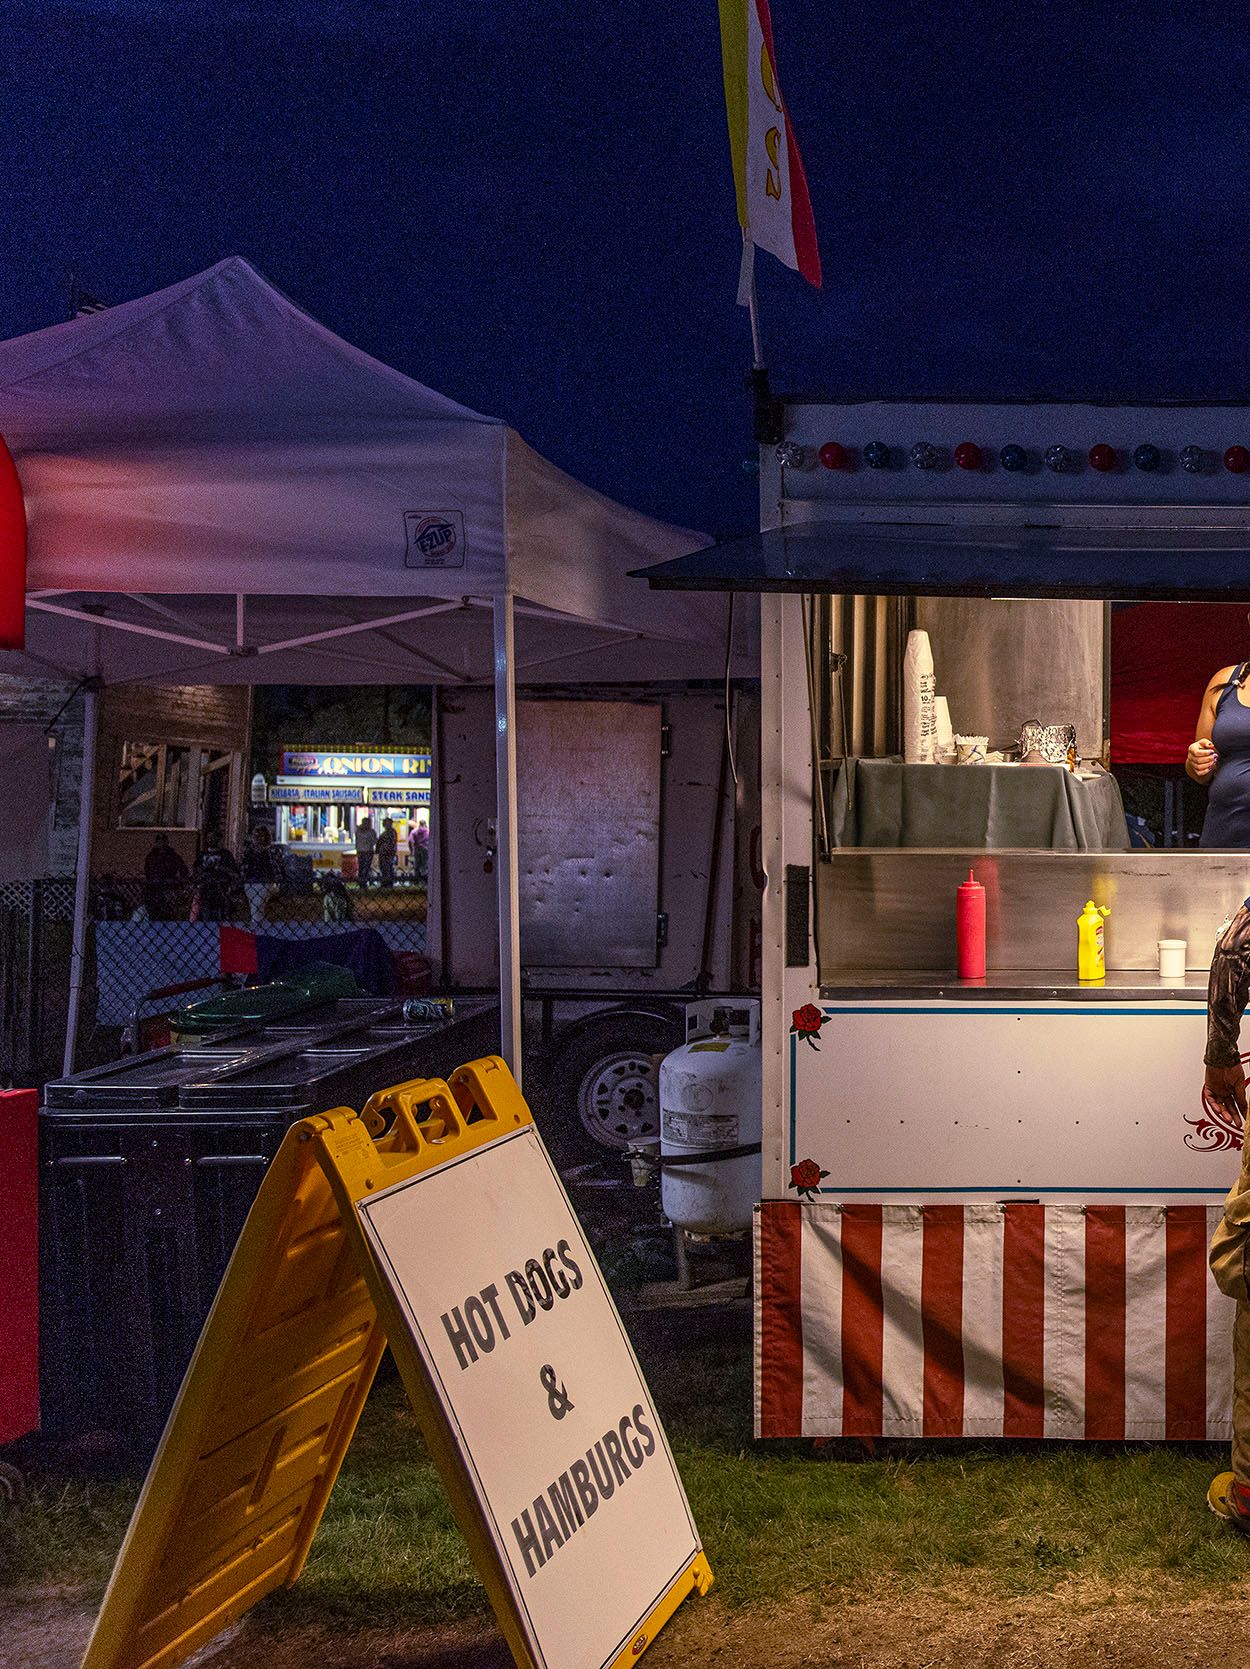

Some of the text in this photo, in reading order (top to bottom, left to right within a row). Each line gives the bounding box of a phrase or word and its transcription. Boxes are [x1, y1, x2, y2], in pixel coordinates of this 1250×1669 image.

[323, 757, 395, 773] ONION
[303, 789, 330, 799] ITALIAN
[332, 790, 361, 799] SAUSAGE
[372, 791, 402, 801] STEAK
[440, 1239, 584, 1370] HOT DOGS
[540, 1363, 575, 1421] &
[510, 1403, 656, 1578] HAMBURGS
